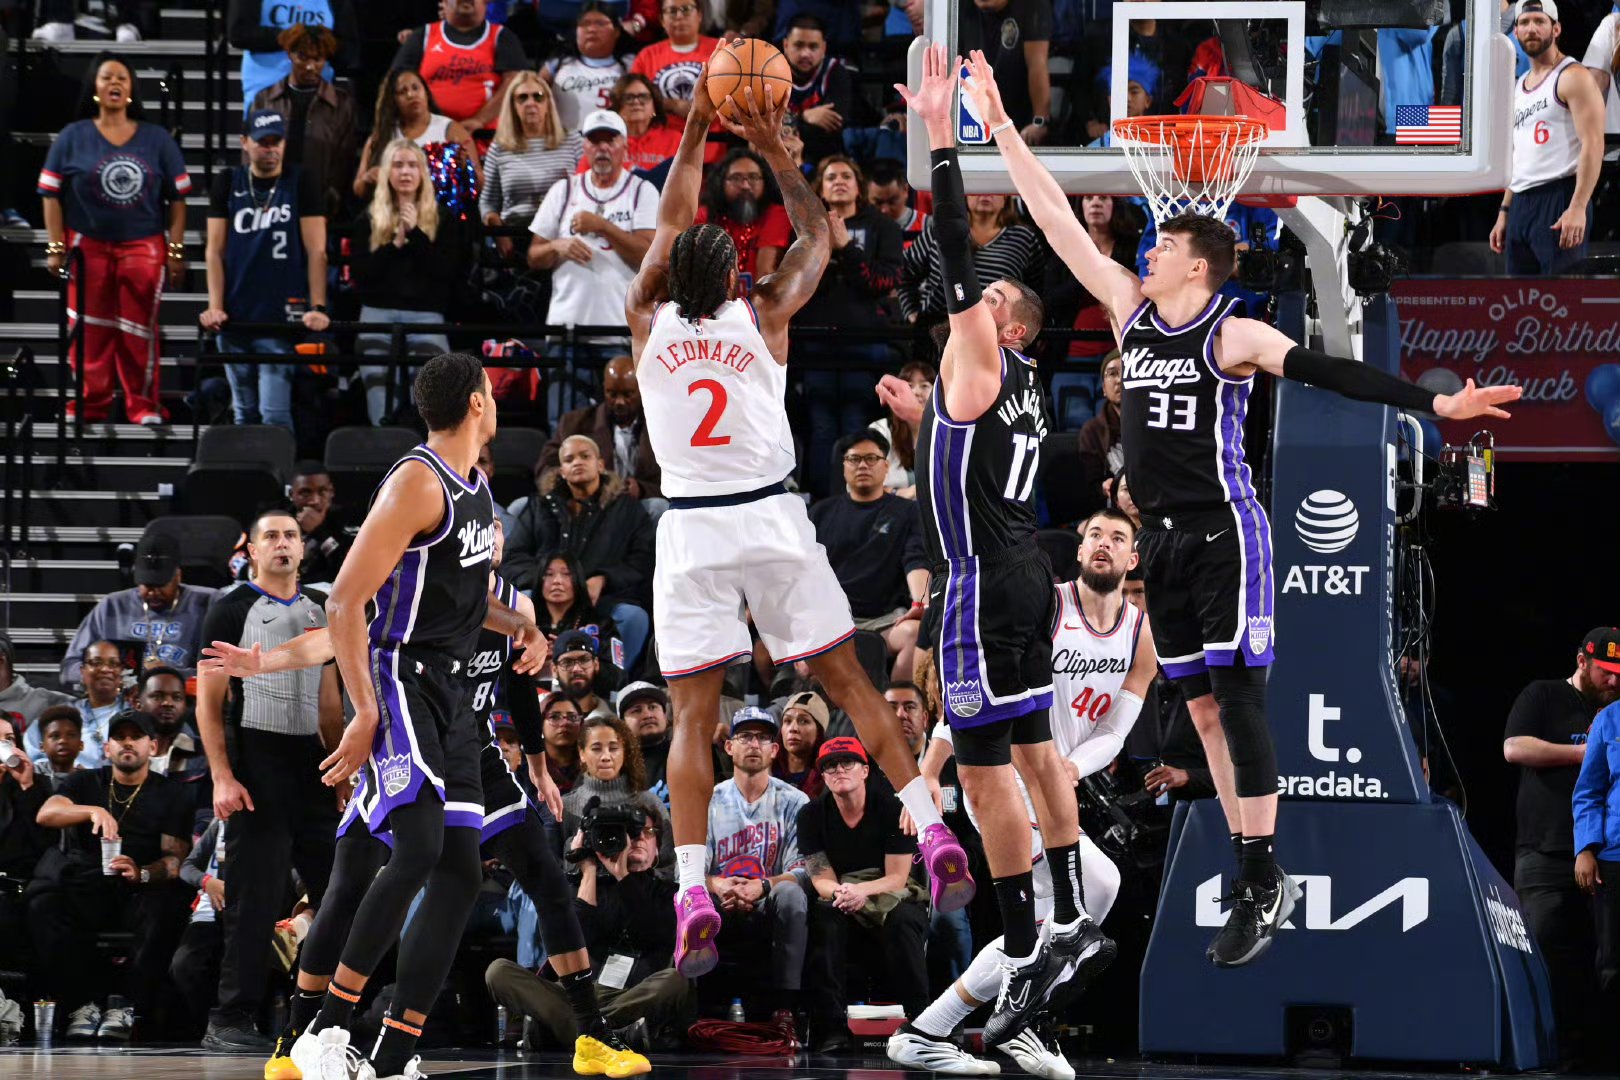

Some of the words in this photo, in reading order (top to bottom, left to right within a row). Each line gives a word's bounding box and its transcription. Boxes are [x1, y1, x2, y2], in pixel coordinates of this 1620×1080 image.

[269, 4, 325, 26] Clips
[962, 125, 979, 138] NBA
[1534, 120, 1550, 145] 6
[234, 203, 292, 234] Clips
[272, 230, 288, 260] 2
[1396, 296, 1466, 305] PRESENTED
[1468, 296, 1485, 305] BY
[1489, 288, 1568, 321] OLIPOP
[1399, 317, 1499, 362] Happy
[1505, 315, 1620, 354] Birthd
[656, 339, 755, 374] LEONARD
[1121, 347, 1201, 390] Kings
[687, 378, 731, 447] 2
[1147, 391, 1197, 431] 33
[1003, 432, 1040, 502] 17
[457, 519, 494, 568] King
[1281, 565, 1370, 595] AT&T
[1052, 648, 1127, 681] Clippers
[472, 681, 493, 712] 8
[950, 694, 982, 705] KINGS
[1071, 687, 1111, 722] 40
[1277, 770, 1389, 799] eradata.
